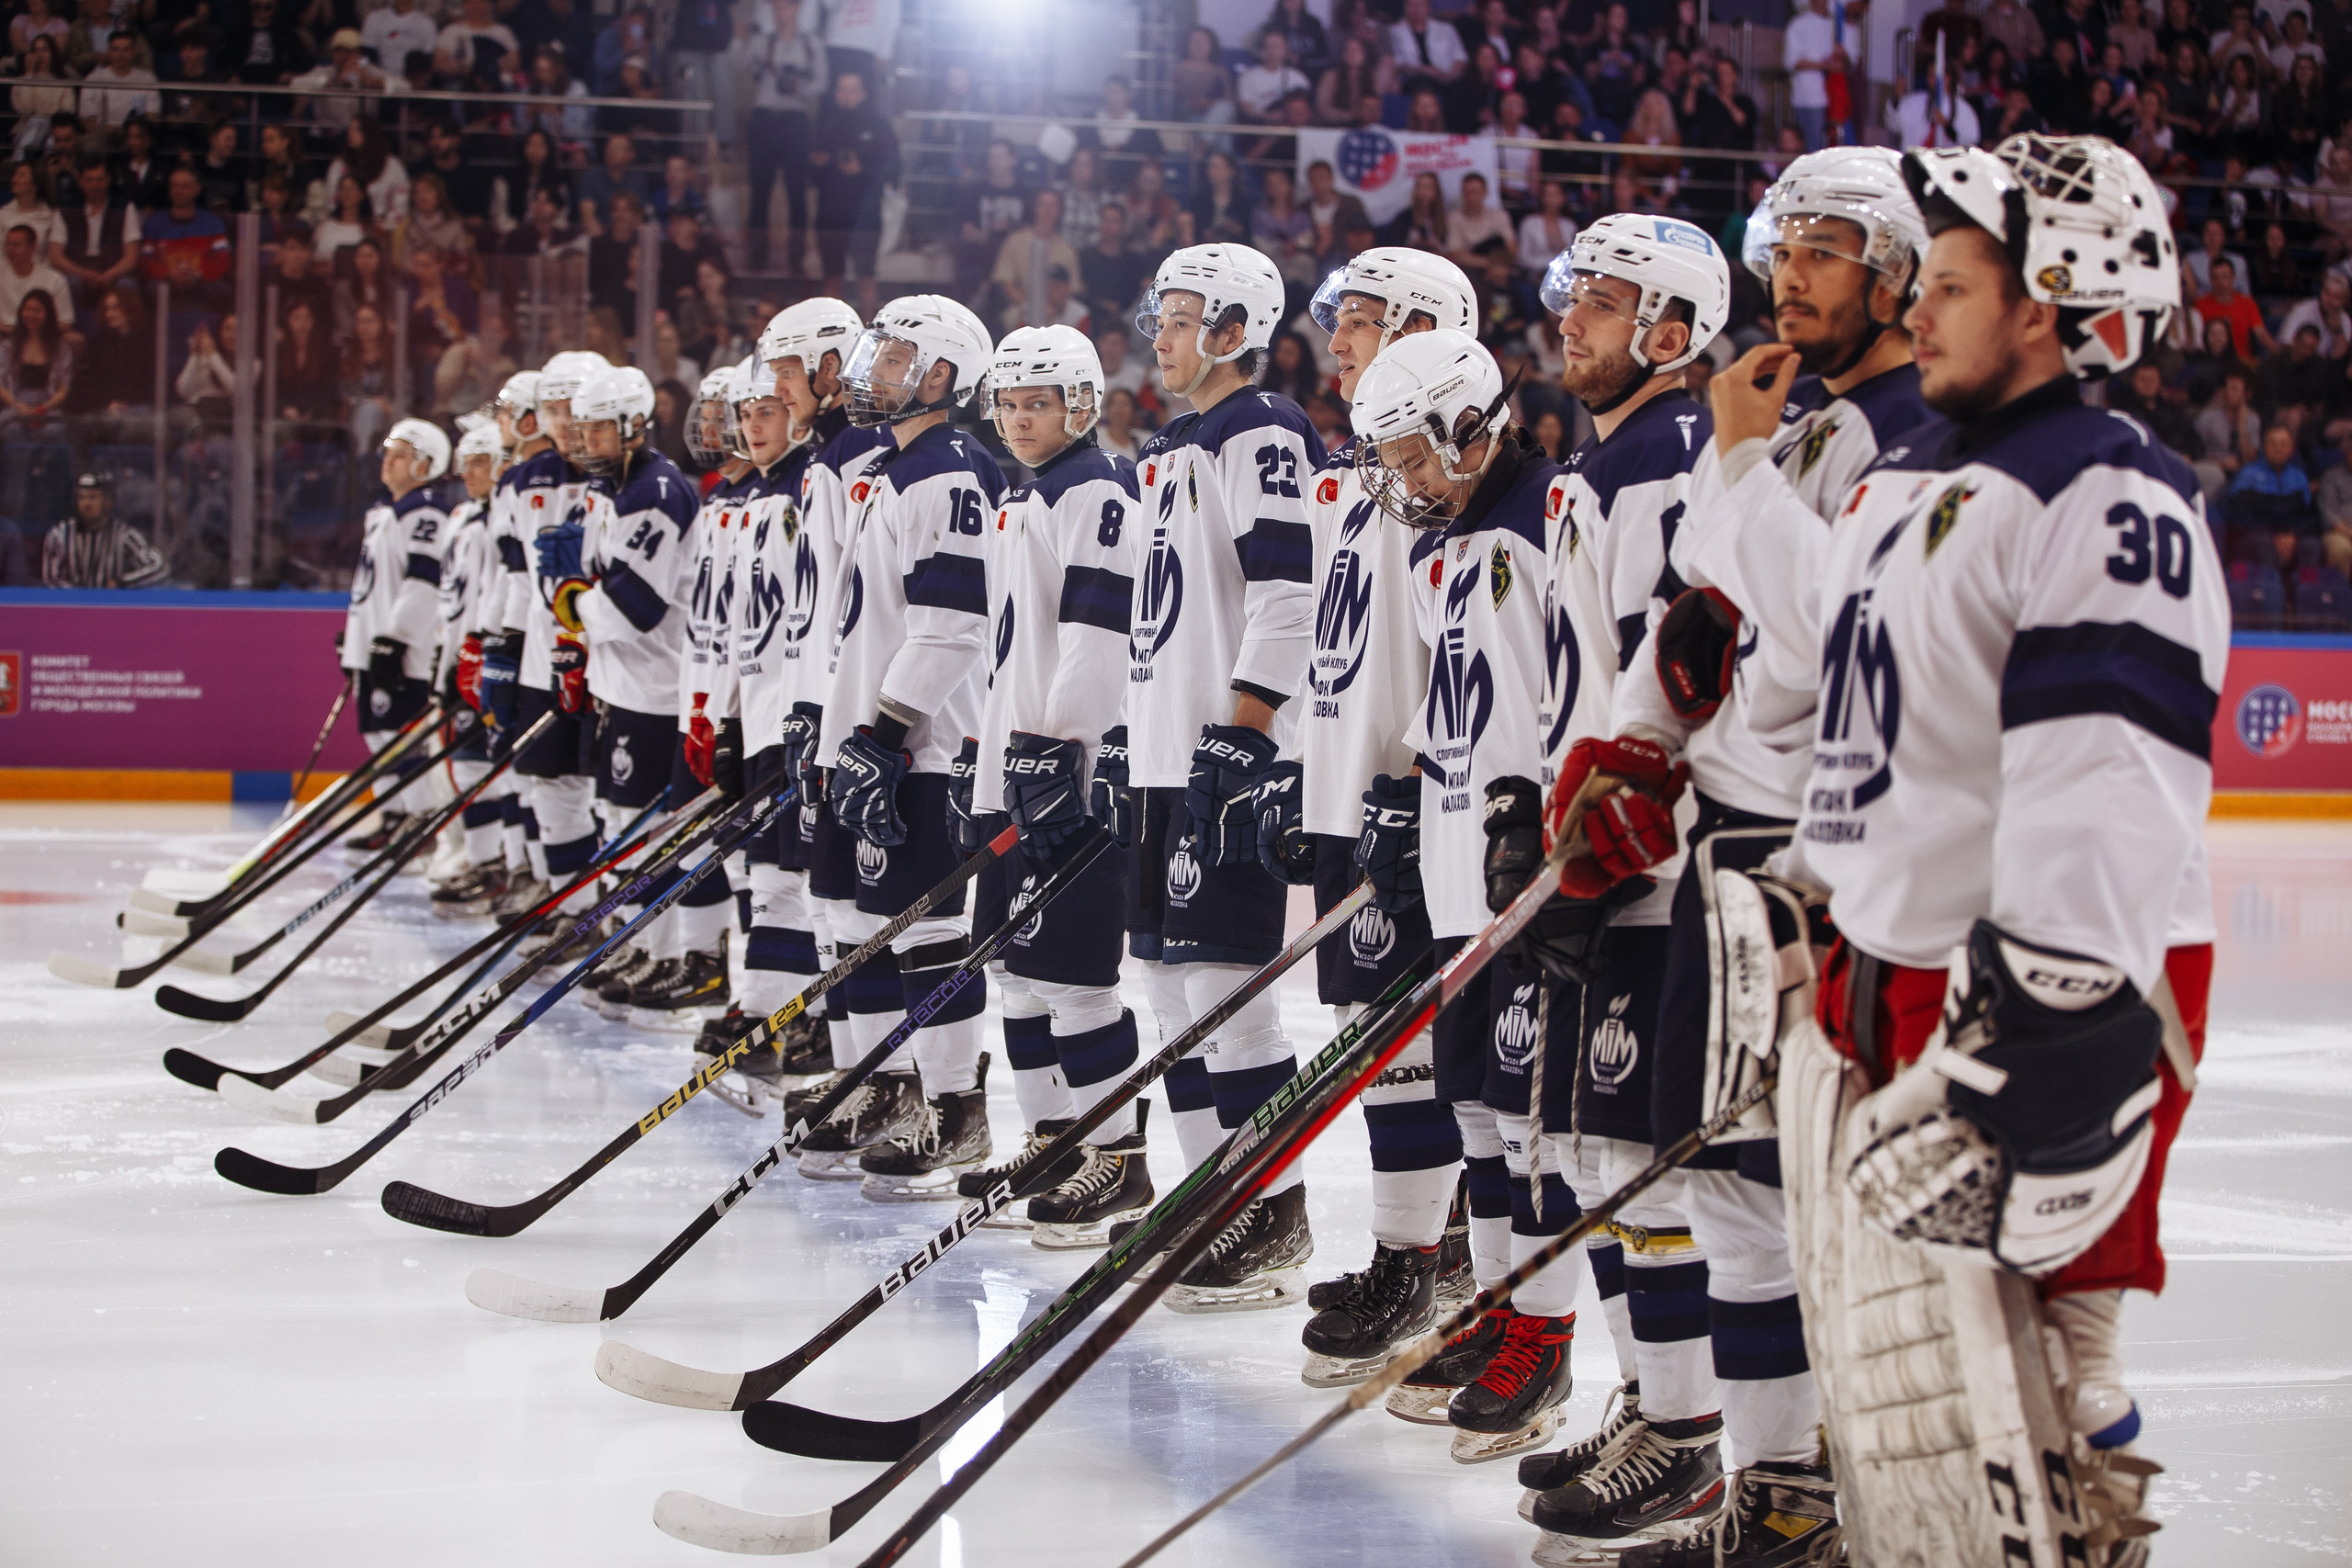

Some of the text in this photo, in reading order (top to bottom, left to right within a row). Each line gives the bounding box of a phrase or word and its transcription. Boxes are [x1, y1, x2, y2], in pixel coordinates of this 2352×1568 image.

[1577, 236, 1606, 245] CCM
[1409, 291, 1442, 306] CCM
[1432, 378, 1464, 401] BAUER
[889, 406, 929, 420] BAUER
[1469, 415, 1489, 441] BAUER
[949, 487, 983, 536] 16
[1098, 499, 1125, 548] 8
[2105, 502, 2192, 600] 30
[1330, 657, 1348, 670] КЛУБ
[2307, 700, 2352, 721] МОС
[1003, 756, 1059, 774] UER
[1195, 737, 1255, 768] UER
[1363, 804, 1419, 828] CC
[574, 875, 651, 938] RIBCOR
[1488, 891, 1543, 948] BAUER
[2027, 968, 2114, 995] CCM
[413, 983, 502, 1055] CCM
[639, 1040, 751, 1136] BAUER
[809, 893, 932, 1002] SUPREME
[887, 969, 969, 1052] RIBCOR
[1251, 1020, 1363, 1135] BAUER
[715, 1117, 810, 1216] CCM
[1220, 1128, 1270, 1175] BAUER
[879, 1179, 1015, 1303] BAUER
[1533, 1385, 1553, 1414] BAUER
